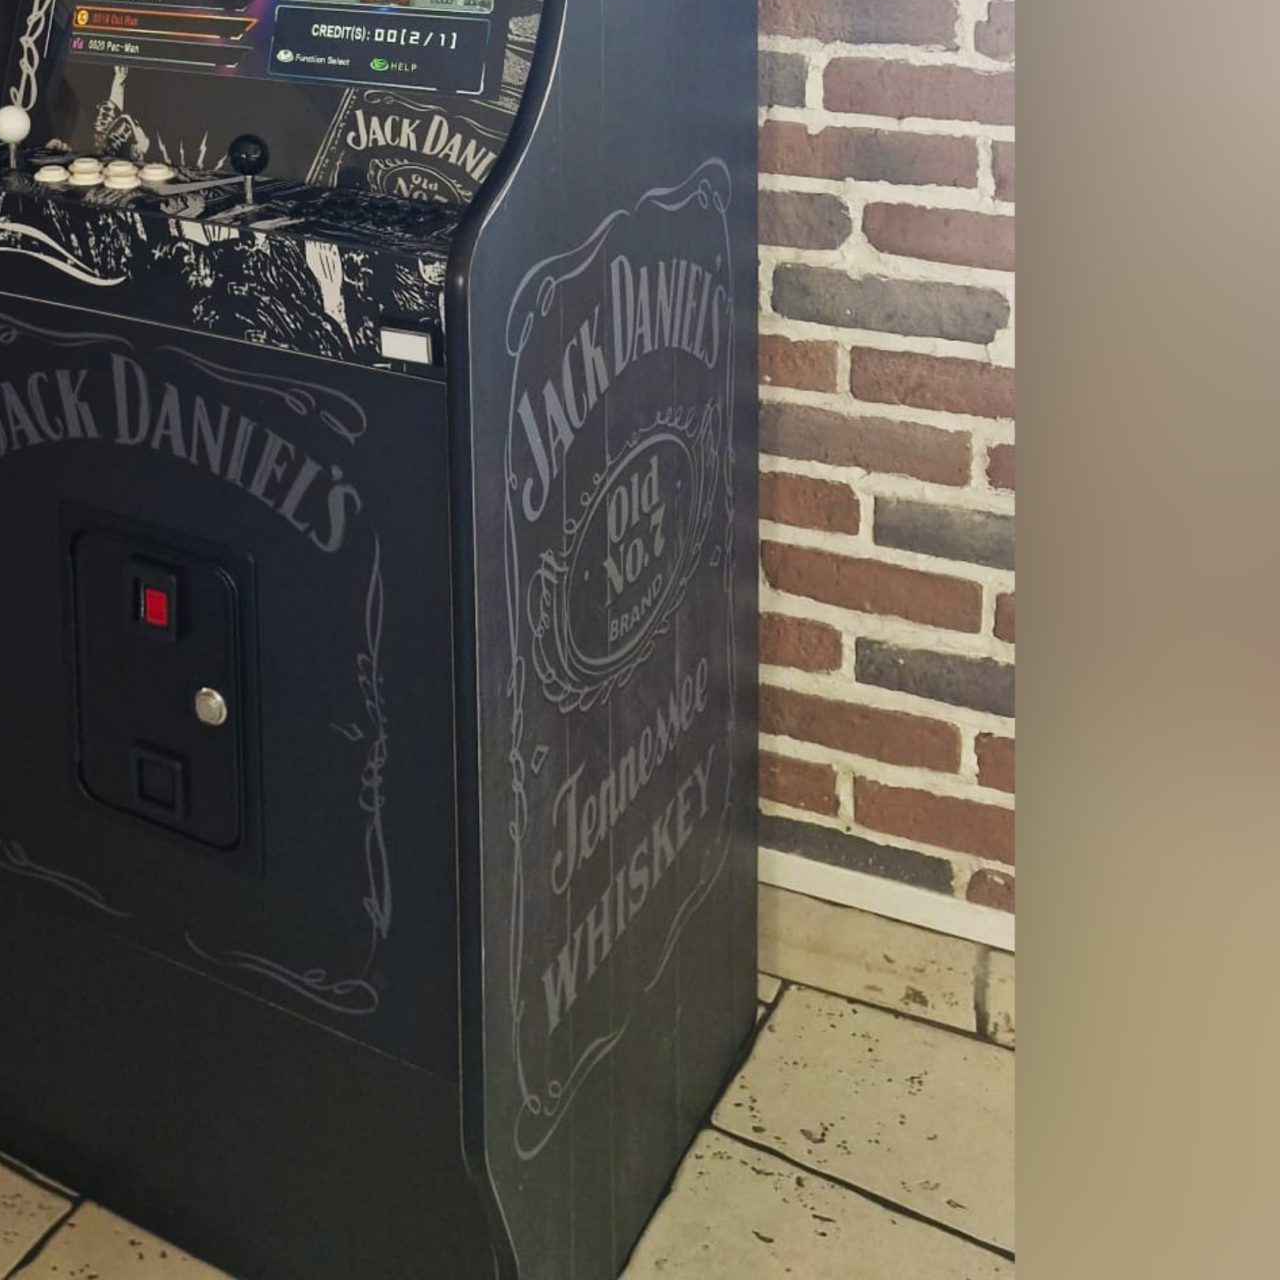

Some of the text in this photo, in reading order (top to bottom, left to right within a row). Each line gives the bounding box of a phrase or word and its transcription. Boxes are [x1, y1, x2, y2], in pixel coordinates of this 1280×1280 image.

[106, 40, 140, 54] Pac-Man
[295, 53, 351, 66] Function Select
[311, 23, 371, 42] CREDIT(S):
[390, 62, 418, 72] HELP
[346, 108, 498, 184] JACK DANI
[516, 254, 727, 522] JACK DANIEL'S
[111, 351, 362, 553] DANIEL'S
[606, 453, 661, 545] Old
[608, 573, 664, 644] BRAND
[551, 656, 708, 896] Tennessee
[540, 741, 718, 1034] WHISKEY
